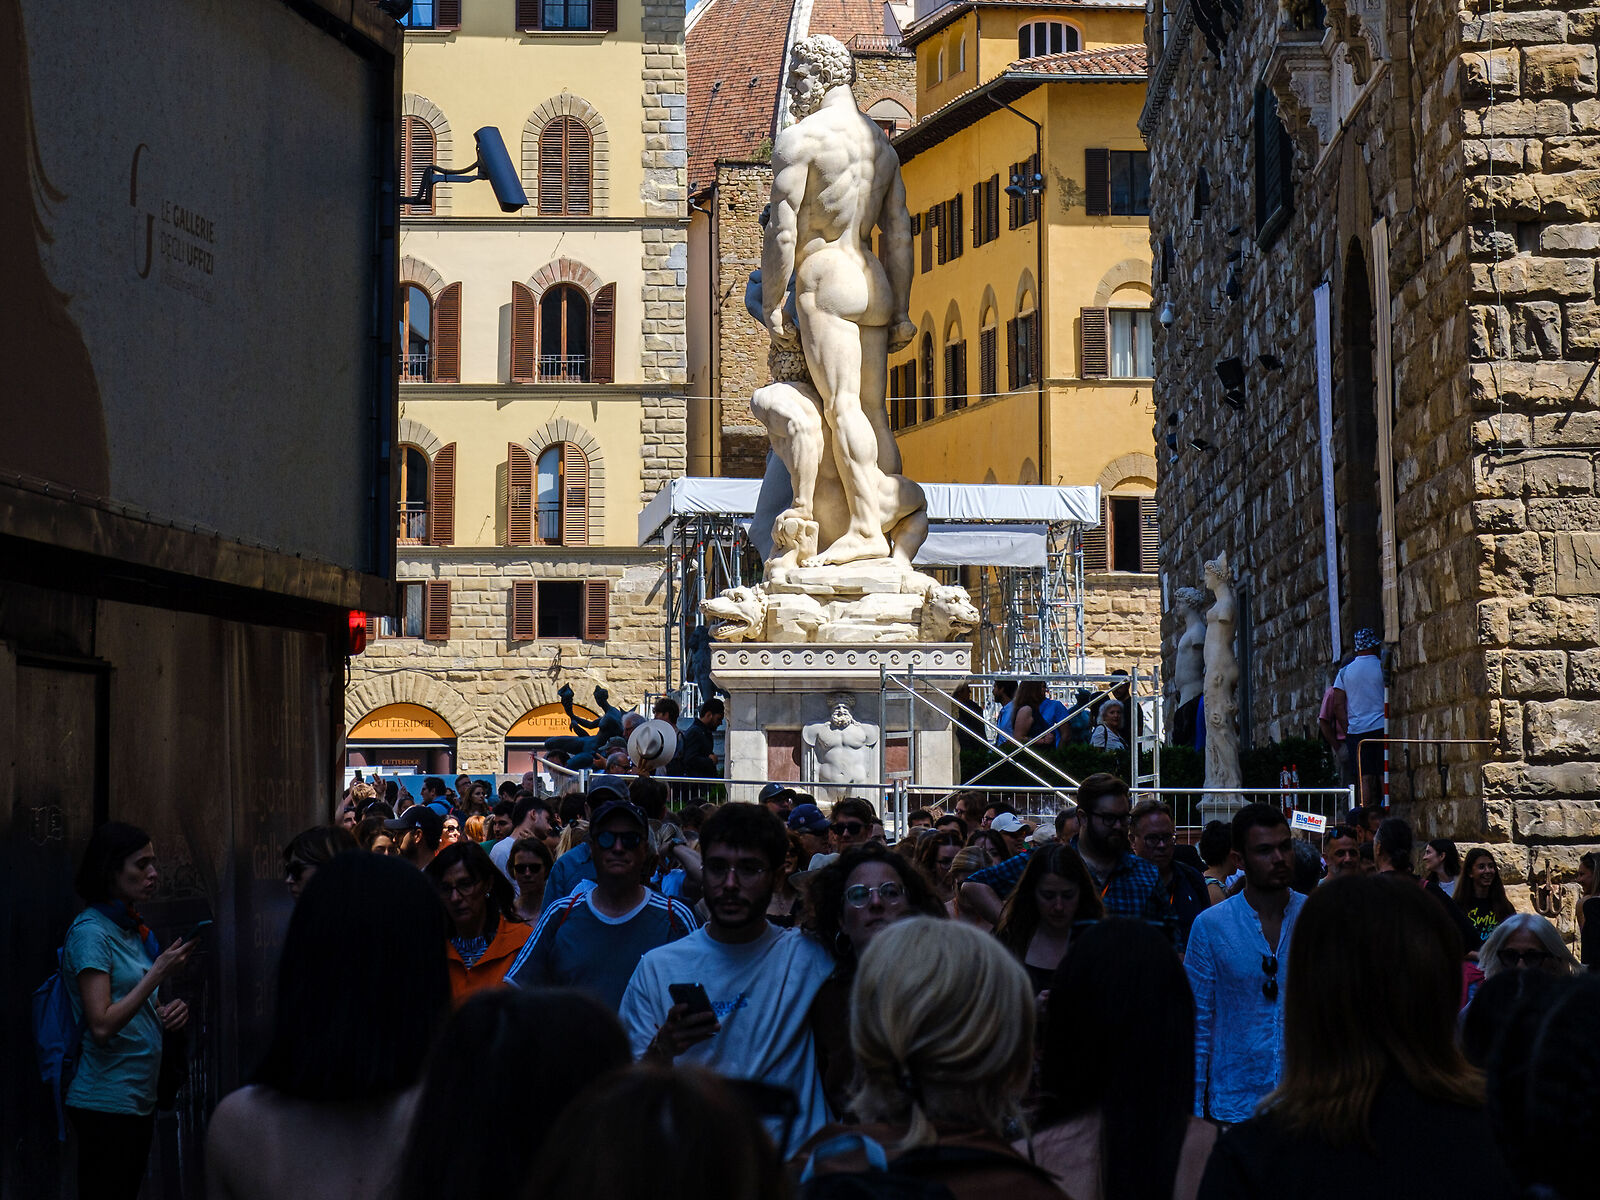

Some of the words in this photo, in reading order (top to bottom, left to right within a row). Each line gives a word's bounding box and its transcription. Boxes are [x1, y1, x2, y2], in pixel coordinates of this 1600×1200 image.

[160, 199, 171, 224] LE
[172, 204, 215, 245] GALLERIE
[160, 231, 185, 263] DEGLI
[186, 242, 214, 276] UFFIZI
[369, 719, 434, 728] GUTTERIDGE
[527, 717, 571, 726] GUTTERI
[1296, 813, 1322, 825] BigMat
[1467, 907, 1498, 928] Smil
